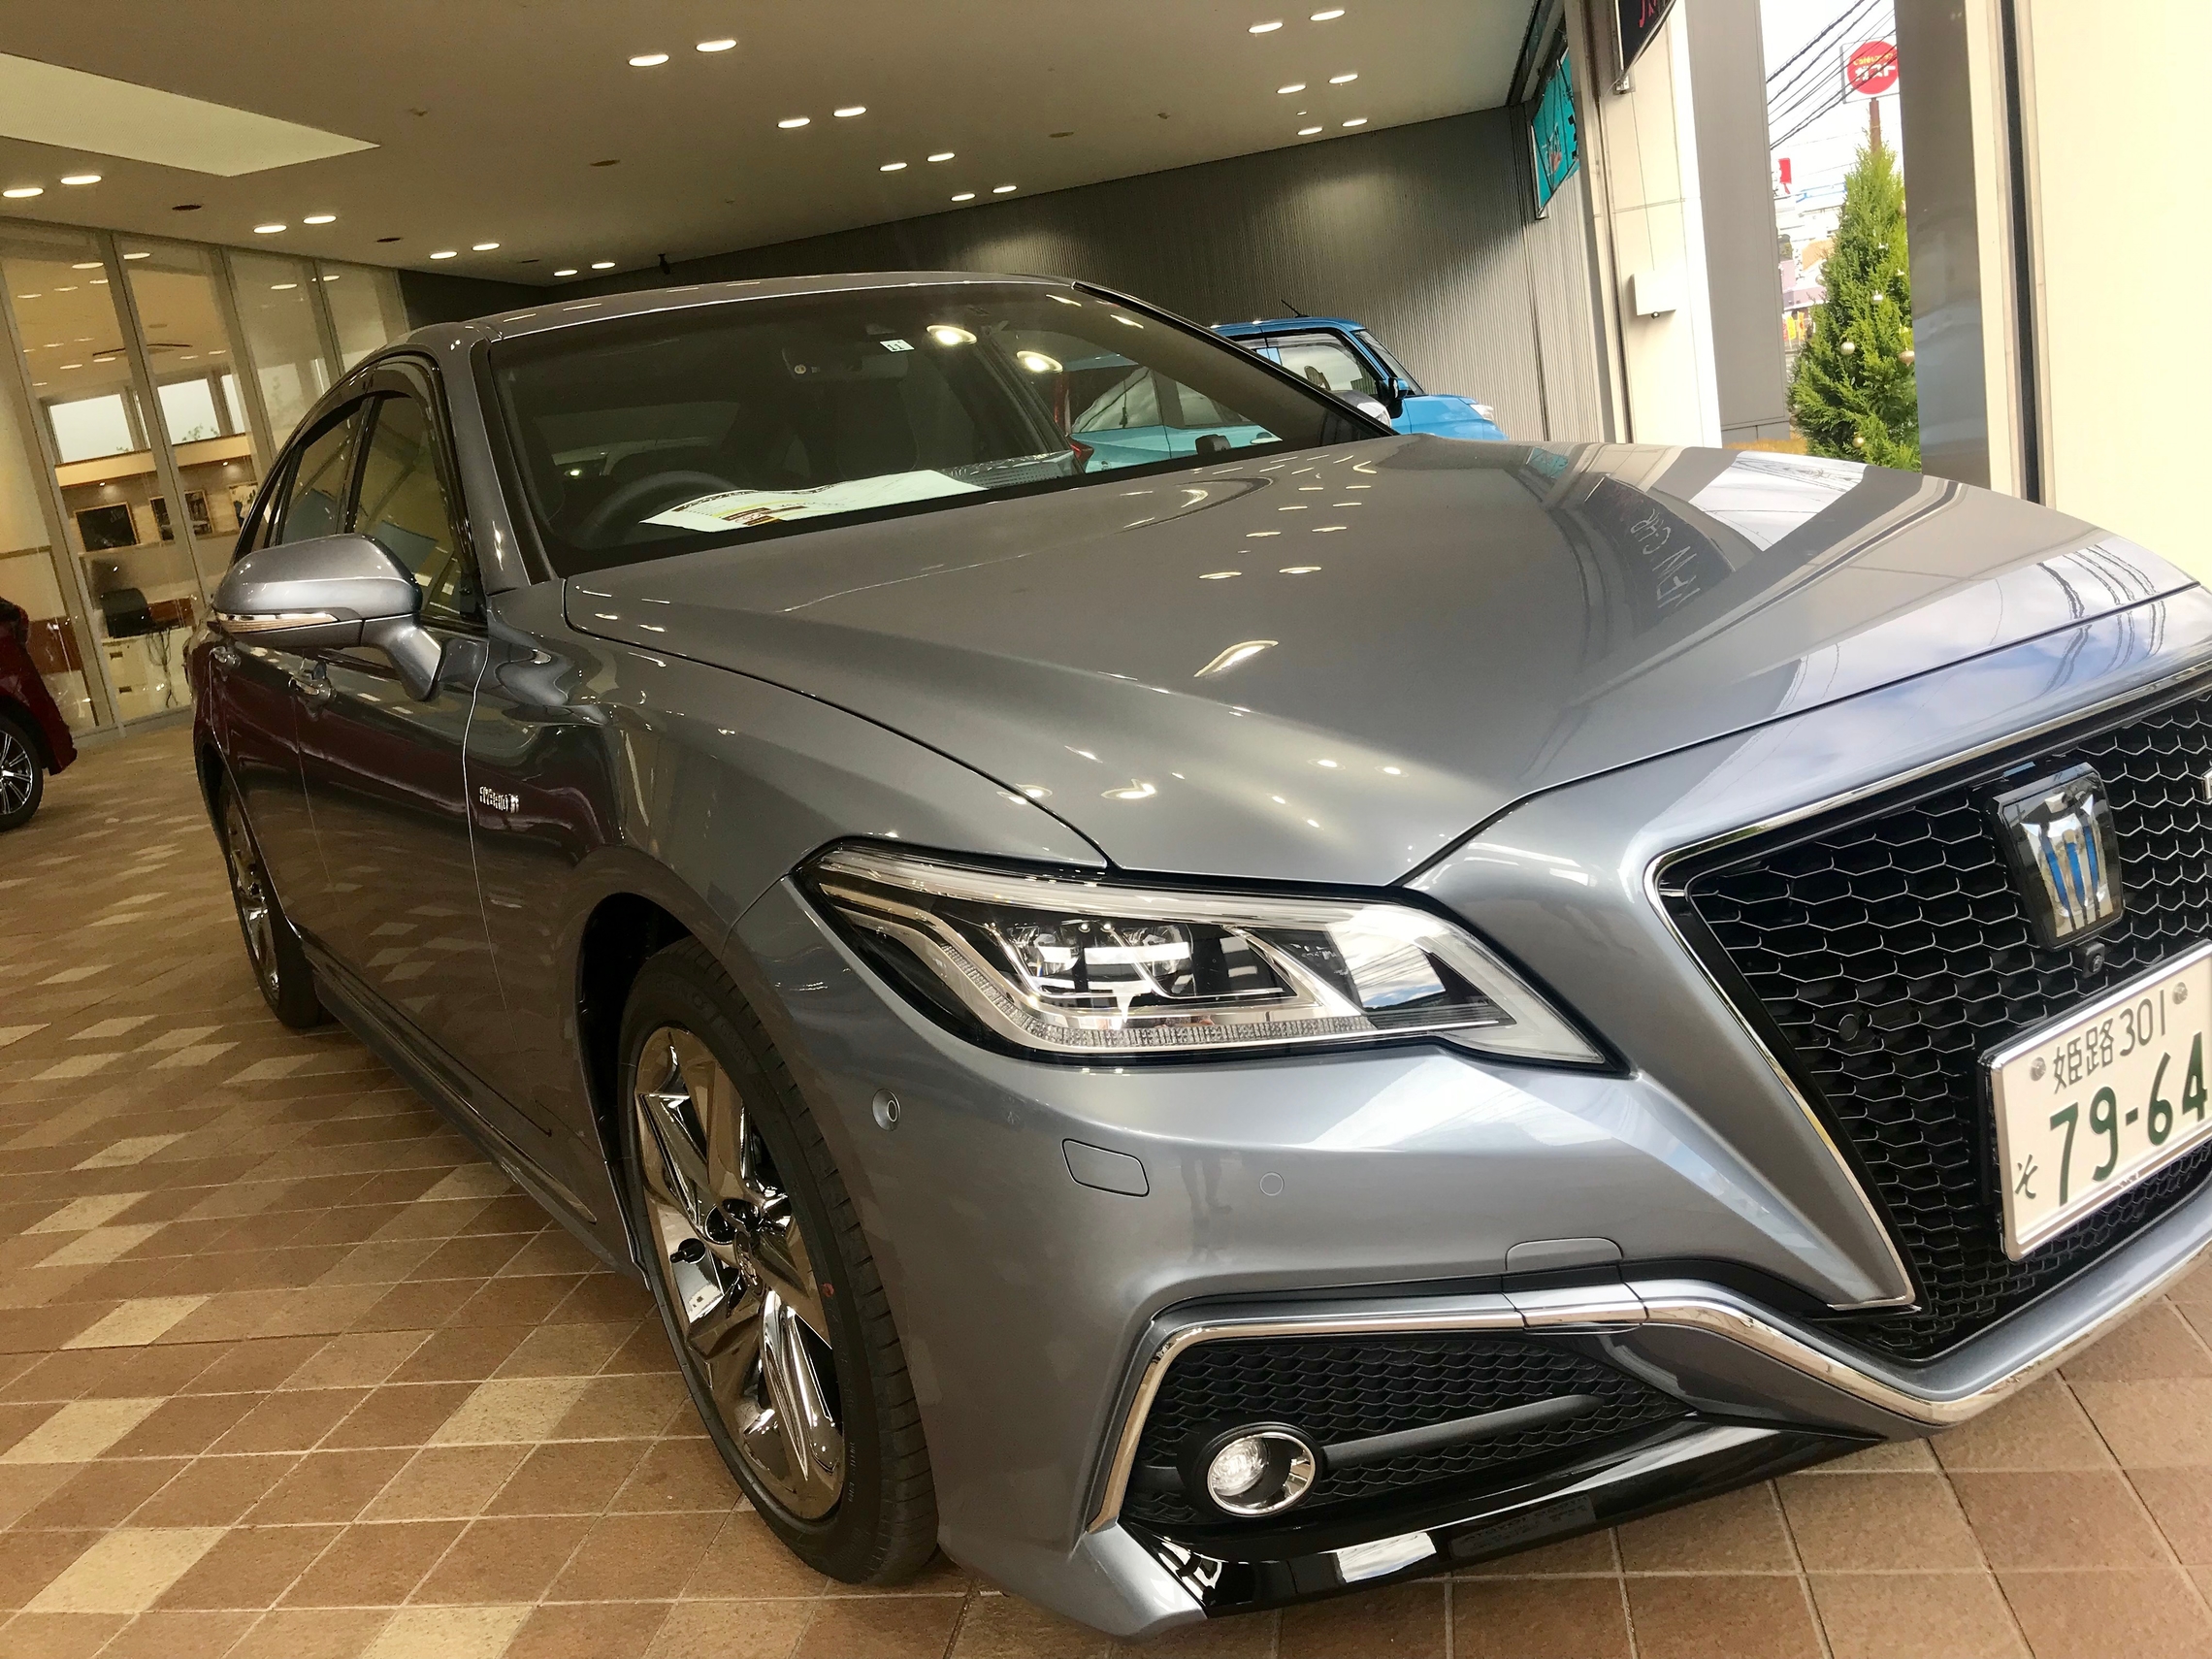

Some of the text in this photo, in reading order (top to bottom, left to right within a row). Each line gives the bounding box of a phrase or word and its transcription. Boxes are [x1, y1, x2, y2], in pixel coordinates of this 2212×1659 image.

[1855, 63, 1897, 81] ガスト
[2014, 1030, 2208, 1207] そ 79-64
